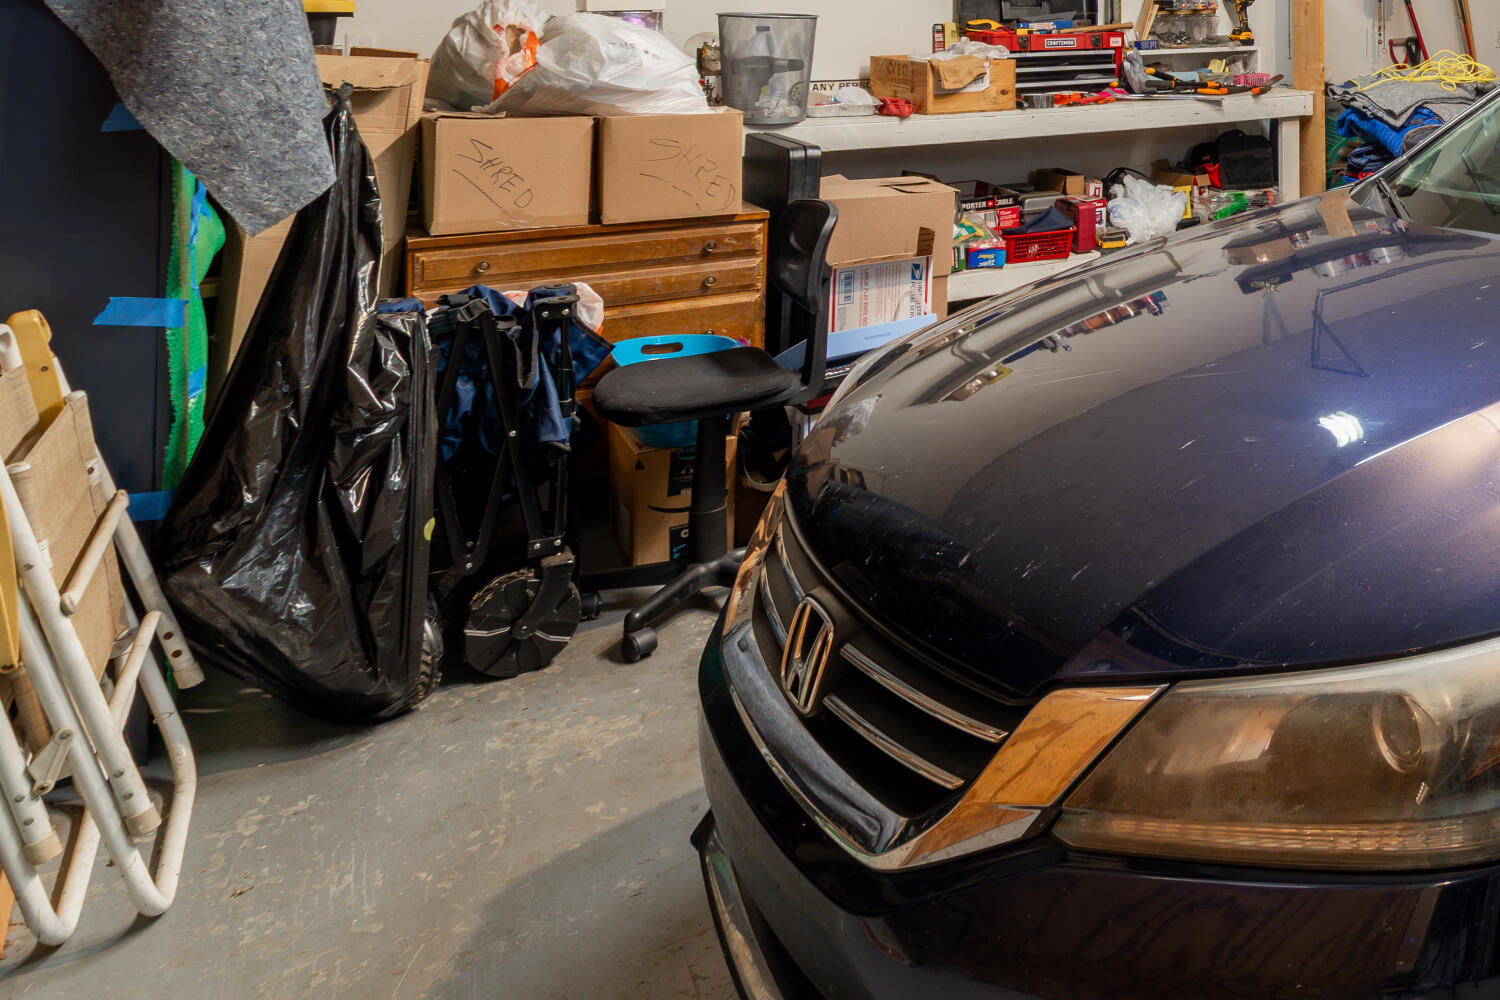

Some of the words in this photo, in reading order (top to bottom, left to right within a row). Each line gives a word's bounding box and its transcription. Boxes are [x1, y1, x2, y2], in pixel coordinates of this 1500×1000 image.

[1047, 39, 1075, 47] CRAFTSMAN
[812, 83, 835, 92] ANY
[455, 138, 534, 209] SHRED
[640, 138, 736, 212] SHRED
[961, 201, 987, 210] PORTER
